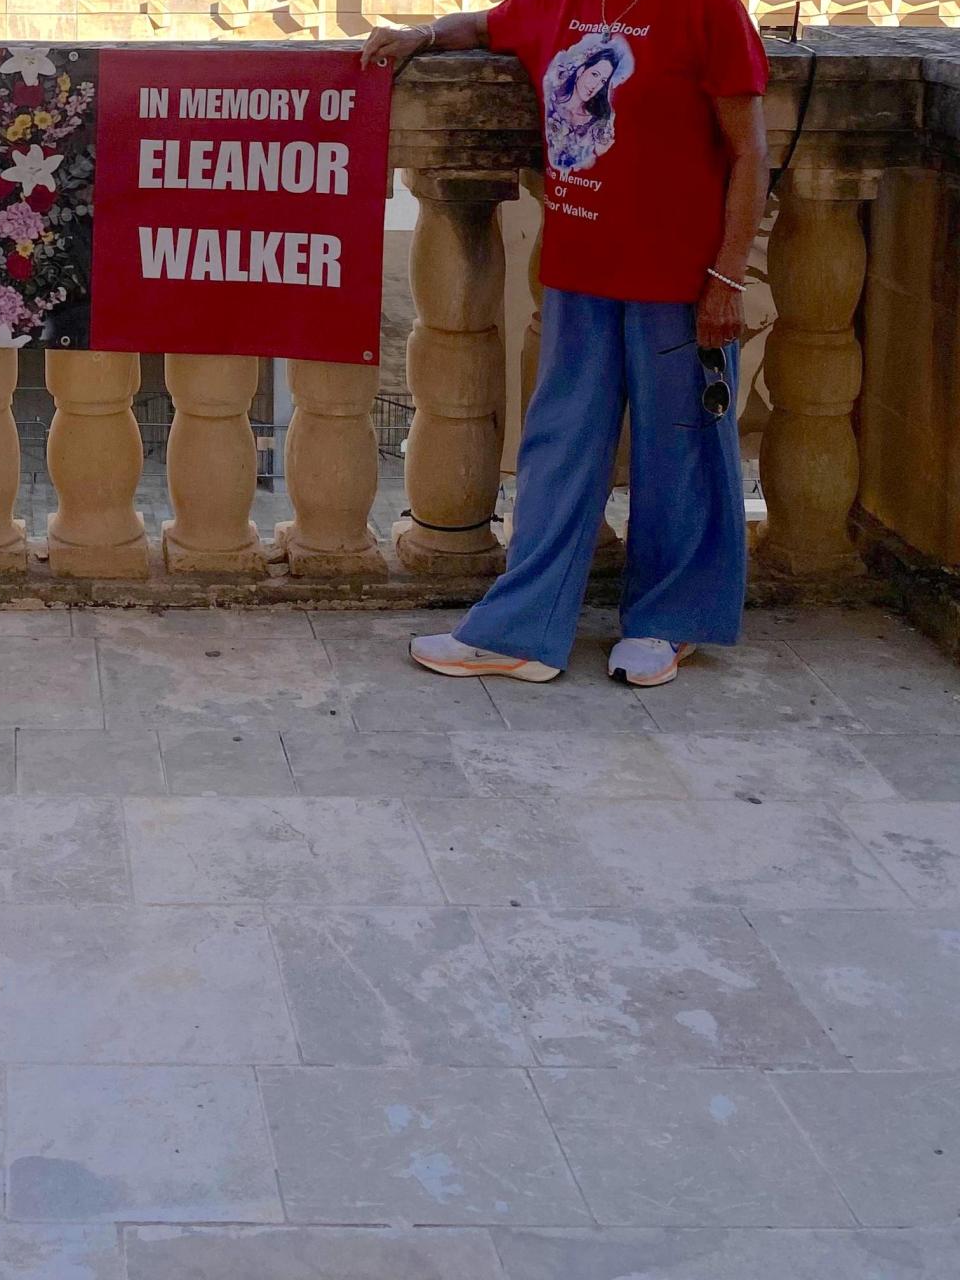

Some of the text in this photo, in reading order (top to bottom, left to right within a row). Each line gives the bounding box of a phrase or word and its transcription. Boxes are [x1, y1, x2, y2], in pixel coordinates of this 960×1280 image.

[569, 19, 651, 37] Donate Blood
[139, 87, 356, 121] IN MEMORY OF
[138, 139, 350, 196] ELEANOR
[554, 185, 568, 197] Of
[562, 202, 599, 221] Walker
[138, 226, 342, 288] WALKER
